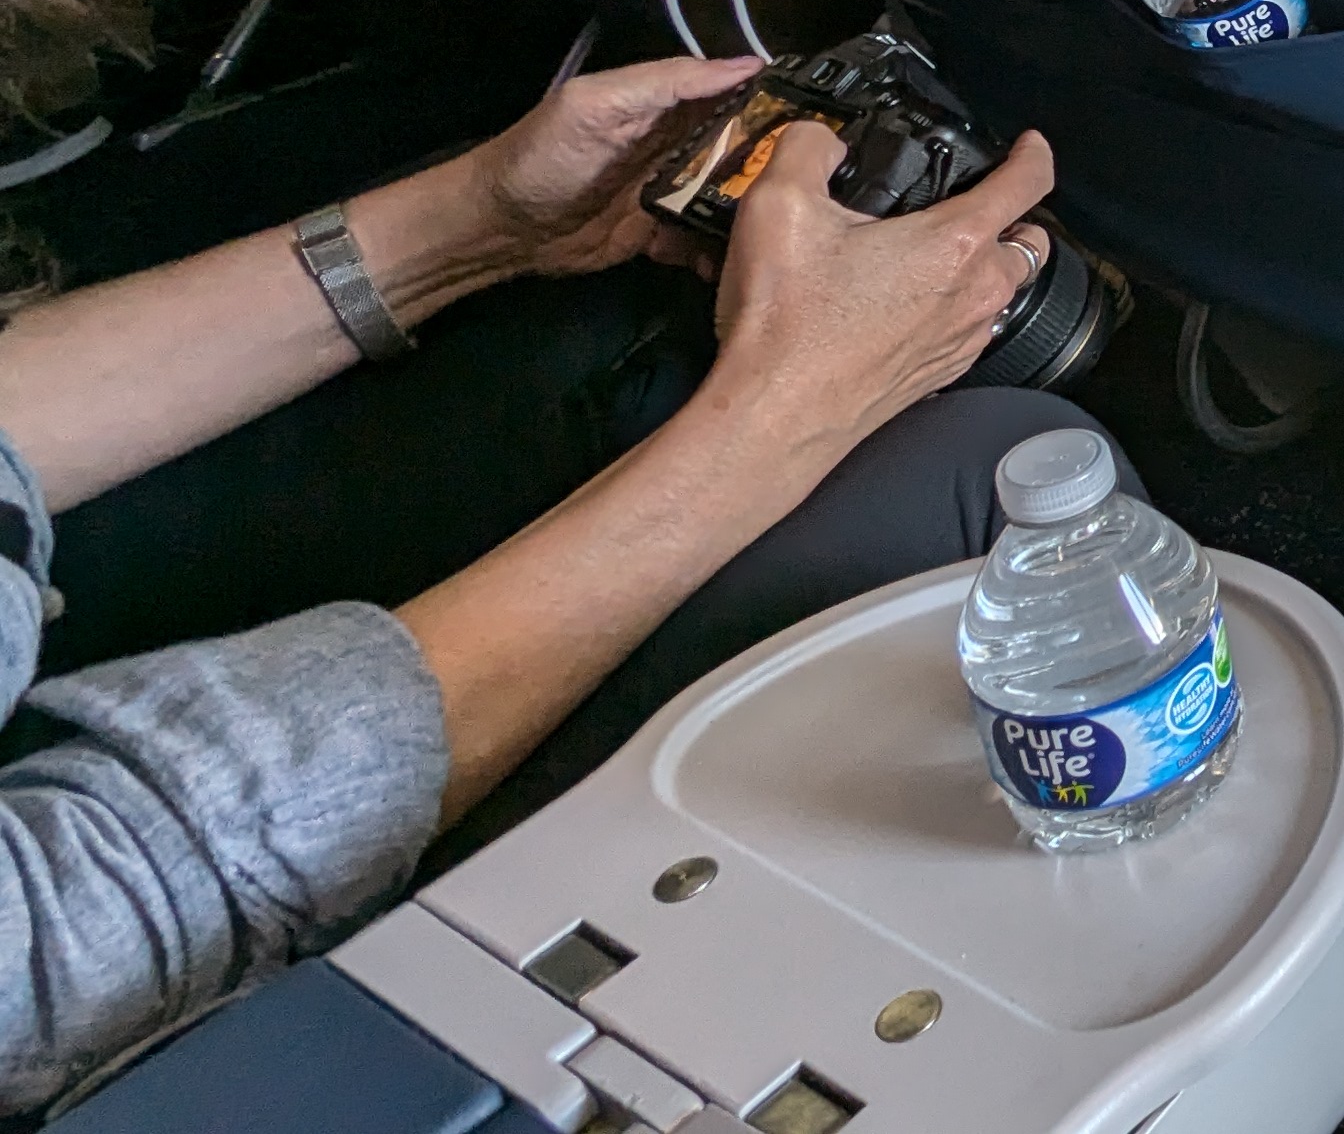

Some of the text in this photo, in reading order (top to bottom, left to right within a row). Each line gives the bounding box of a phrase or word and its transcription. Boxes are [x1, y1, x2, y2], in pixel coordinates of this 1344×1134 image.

[1214, 4, 1271, 36] Pure
[1228, 23, 1274, 46] Life
[1172, 673, 1211, 716] HEALTHY
[1174, 684, 1213, 725] HYDRATION
[1004, 719, 1096, 750] Pure
[1019, 749, 1091, 785] Life
